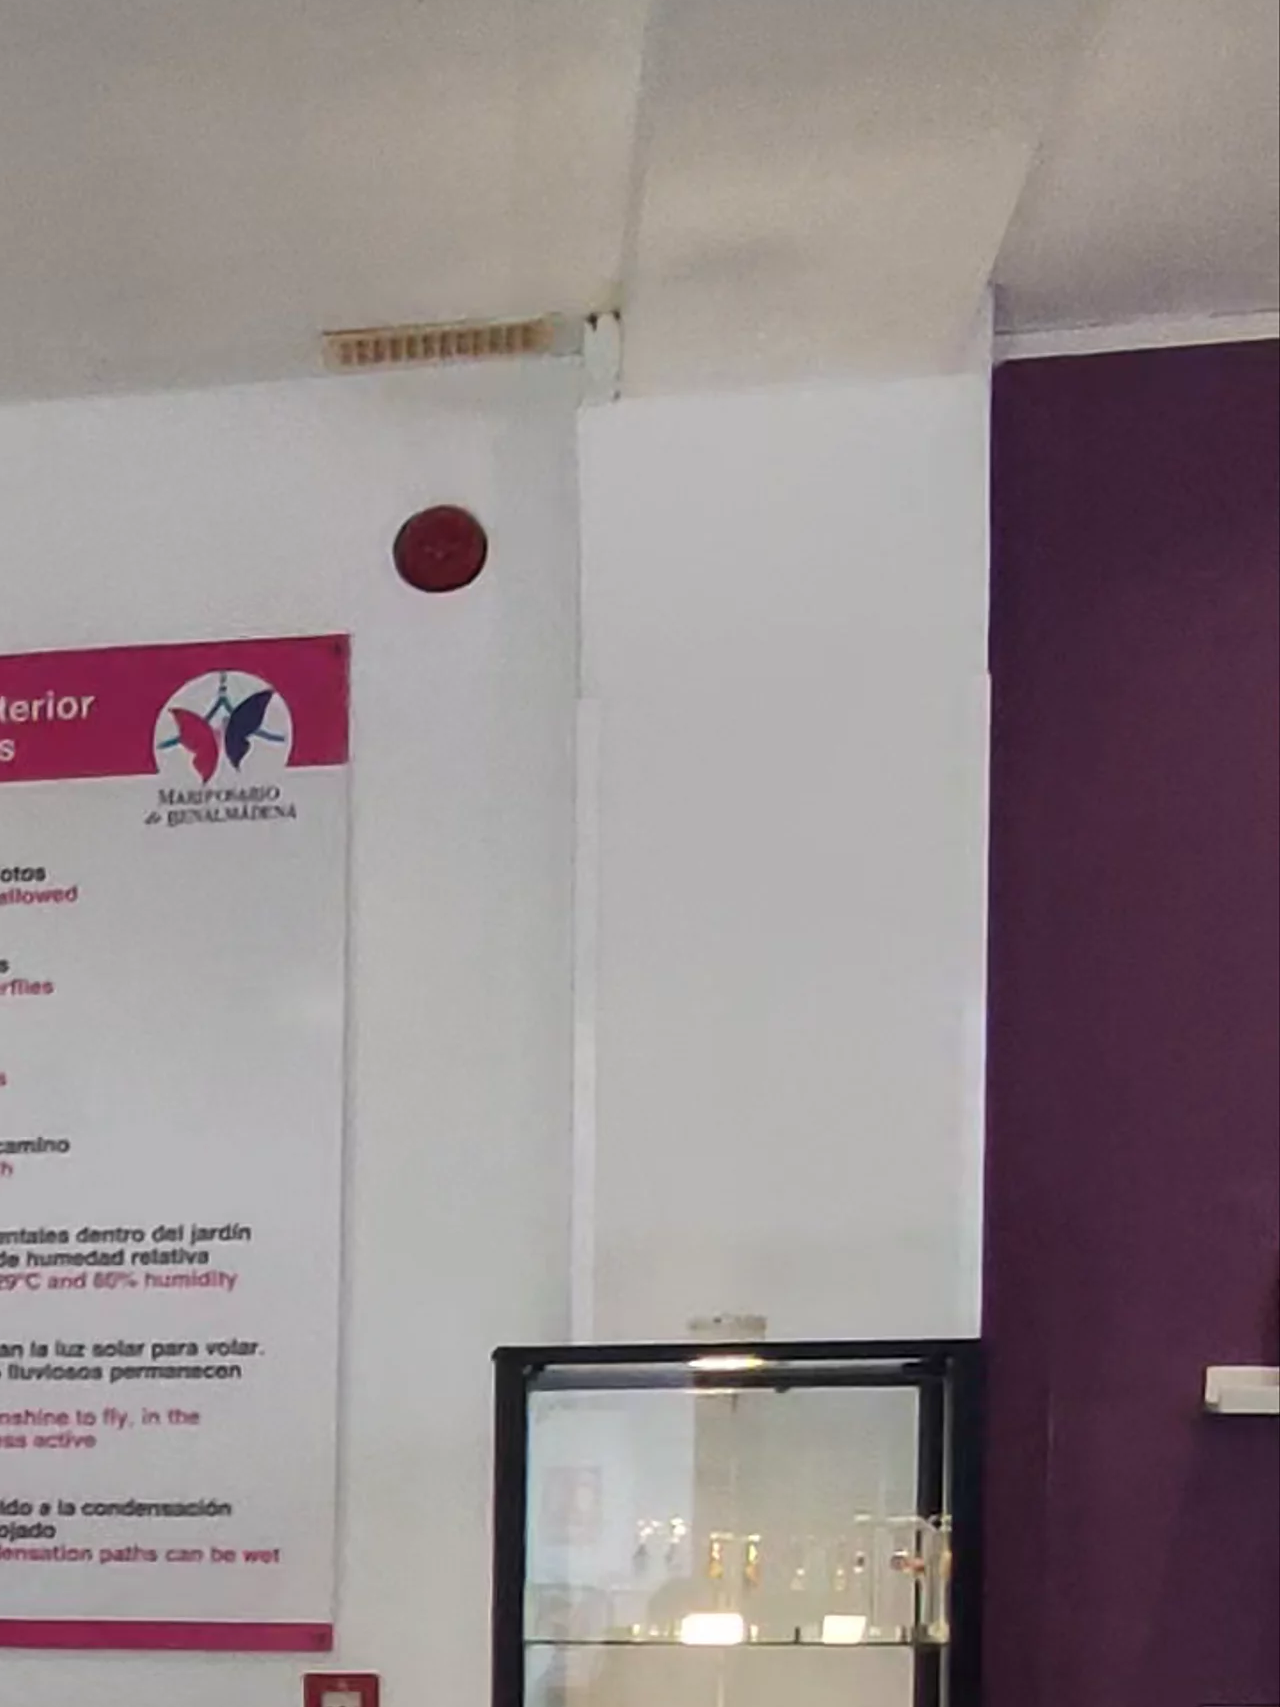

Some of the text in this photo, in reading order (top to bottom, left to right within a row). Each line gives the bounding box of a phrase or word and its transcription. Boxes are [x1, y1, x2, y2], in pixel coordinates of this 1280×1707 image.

[75, 1226, 146, 1244] dentro
[150, 1224, 185, 1244] del
[25, 1248, 126, 1268] humedad
[130, 1247, 210, 1266] relativa
[47, 1272, 88, 1290] and
[144, 1270, 239, 1292] humidity
[29, 1340, 49, 1359] la
[54, 1340, 87, 1359] luz
[91, 1339, 146, 1358] solar
[150, 1341, 200, 1362] para
[75, 1409, 98, 1427] to
[141, 1407, 161, 1425] in
[167, 1408, 201, 1426] the
[32, 1430, 98, 1449] active
[57, 1498, 77, 1517] la
[98, 1545, 159, 1566] paths
[164, 1548, 205, 1563] can
[209, 1546, 237, 1564] be
[242, 1548, 281, 1565] wet
